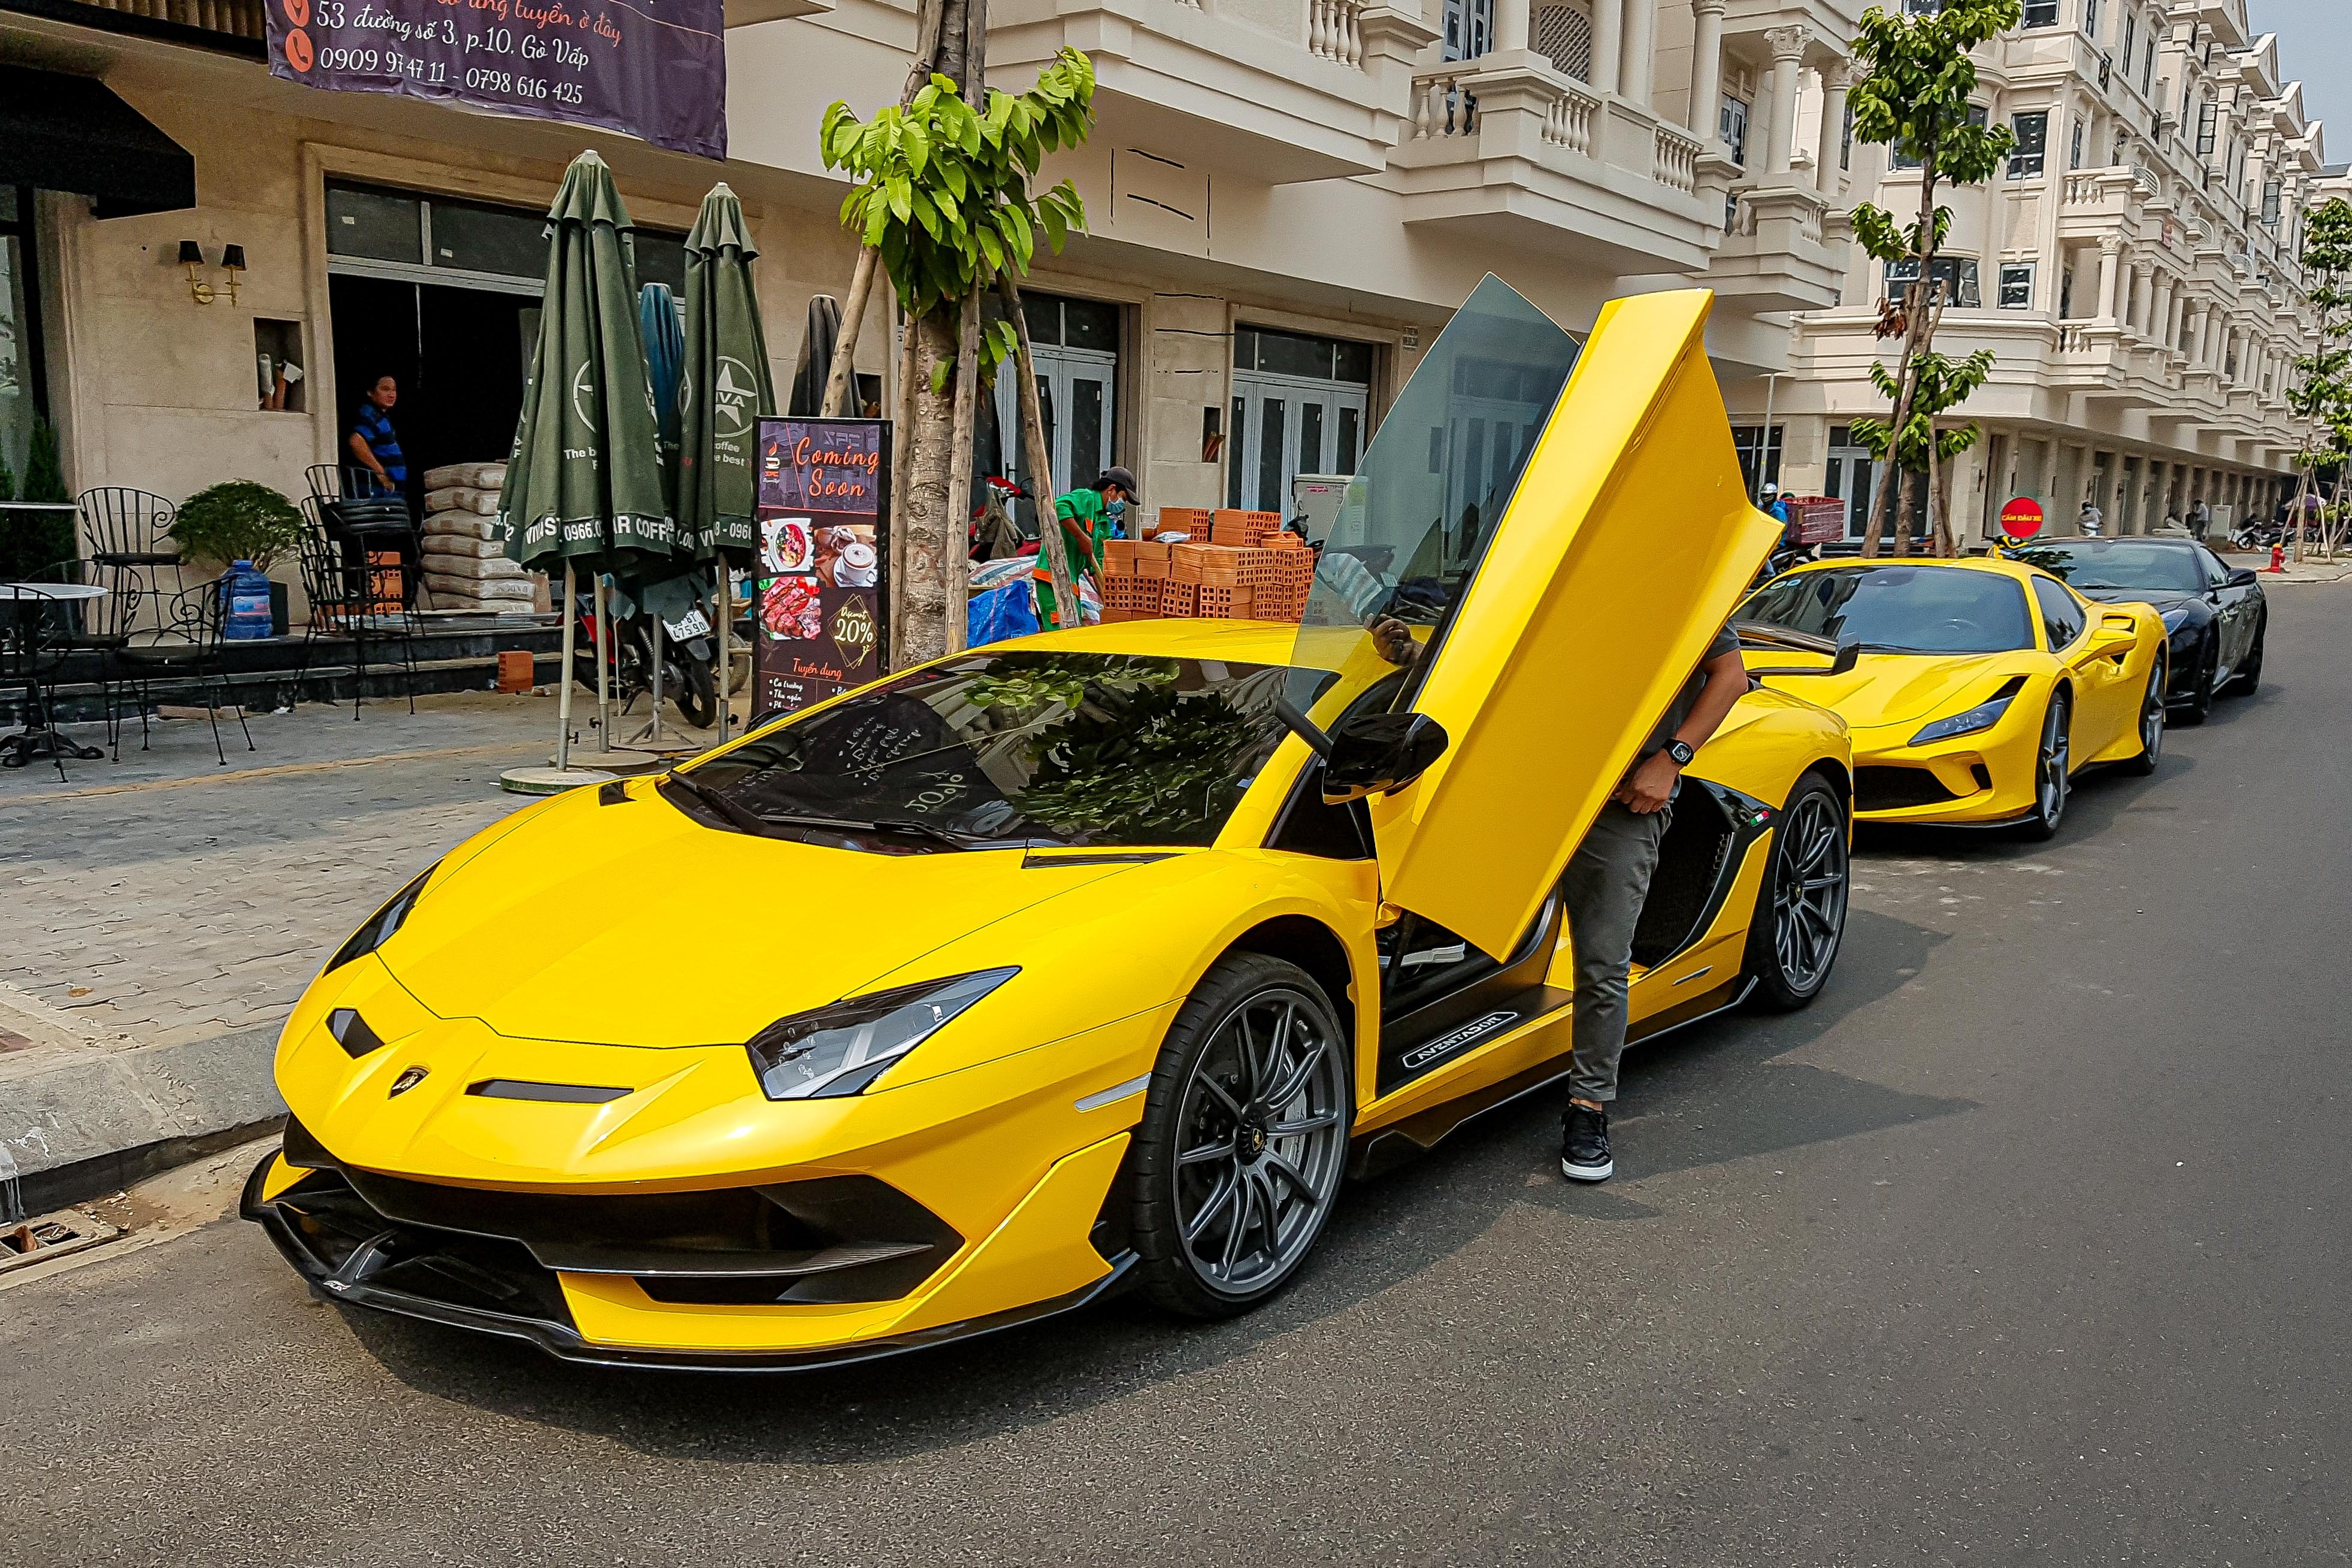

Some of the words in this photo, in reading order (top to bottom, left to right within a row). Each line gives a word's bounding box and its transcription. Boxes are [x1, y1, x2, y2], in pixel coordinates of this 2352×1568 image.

[317, 1, 346, 29] 53
[353, 4, 412, 41] đường
[415, 21, 438, 40] số
[521, 34, 549, 59] Gò
[552, 38, 589, 71] Vấp
[593, 11, 623, 47] đây
[320, 47, 378, 71] 0909
[386, 51, 404, 73] 97
[406, 59, 425, 79] 47
[428, 62, 446, 82] 11
[465, 68, 511, 92] 0798
[517, 76, 547, 98] 616
[552, 82, 583, 104] 425
[564, 450, 586, 460] The
[723, 454, 744, 467] best
[795, 435, 879, 475] Coming
[809, 468, 865, 497] Soon
[636, 517, 670, 543] COFF
[834, 618, 873, 643] 20%
[793, 658, 818, 677] Tuyển
[820, 662, 843, 680] dụng
[1417, 1016, 1502, 1061] AVENTADOR
